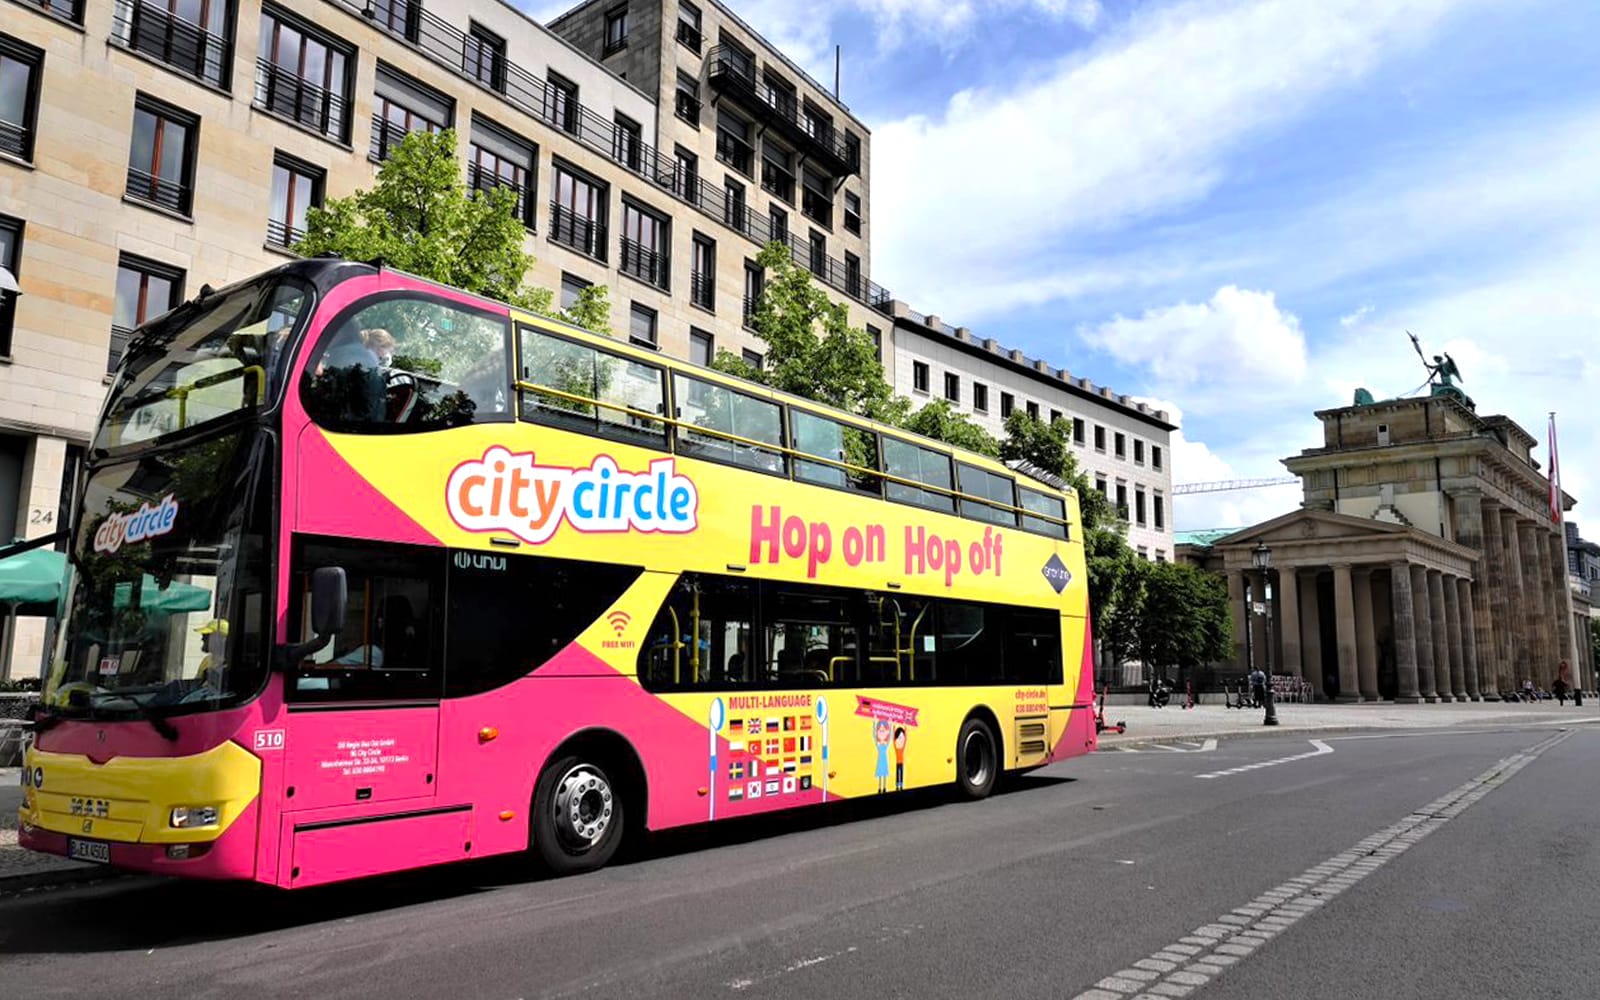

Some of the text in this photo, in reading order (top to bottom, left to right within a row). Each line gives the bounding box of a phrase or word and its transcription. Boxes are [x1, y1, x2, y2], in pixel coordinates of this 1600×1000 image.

[458, 460, 690, 530] city circle
[30, 508, 53, 525] 24
[95, 498, 175, 547] city circle
[749, 504, 1003, 587] Hop on Hop off
[602, 640, 619, 648] FREE
[729, 694, 812, 709] MULTI-LANGUAGE
[256, 733, 282, 747] 510
